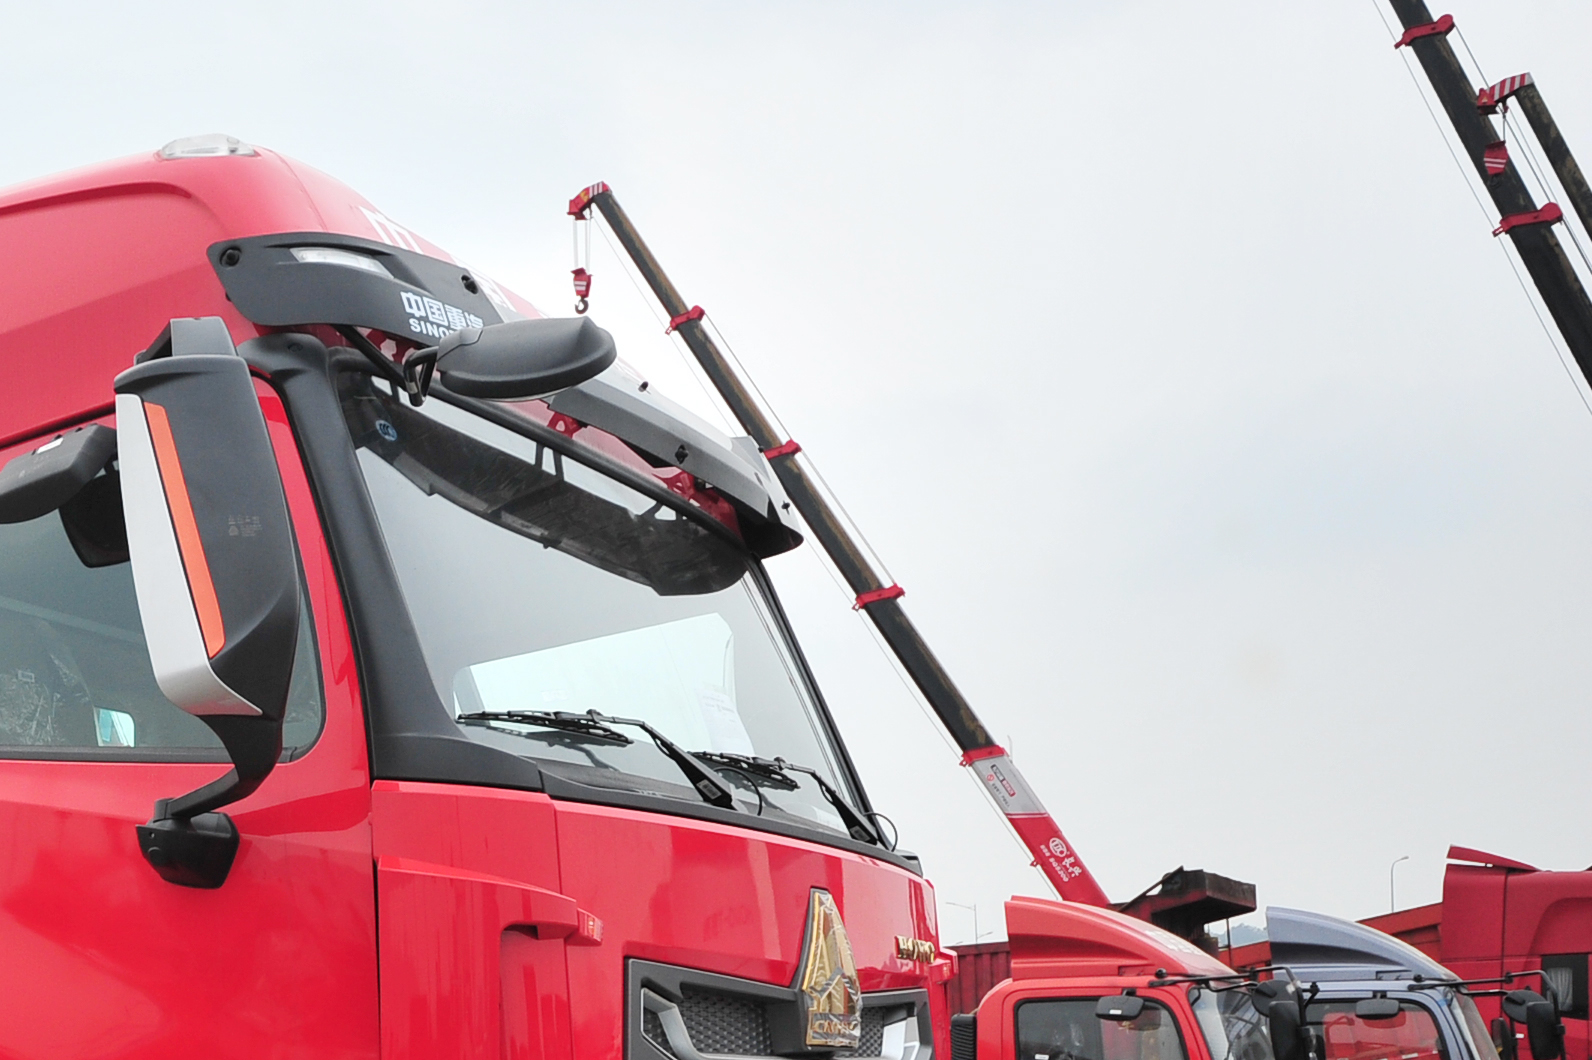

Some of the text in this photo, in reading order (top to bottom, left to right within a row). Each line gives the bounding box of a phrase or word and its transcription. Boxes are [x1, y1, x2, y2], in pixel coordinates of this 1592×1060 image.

[400, 291, 484, 329] 中国重汽
[409, 318, 454, 338] SINO
